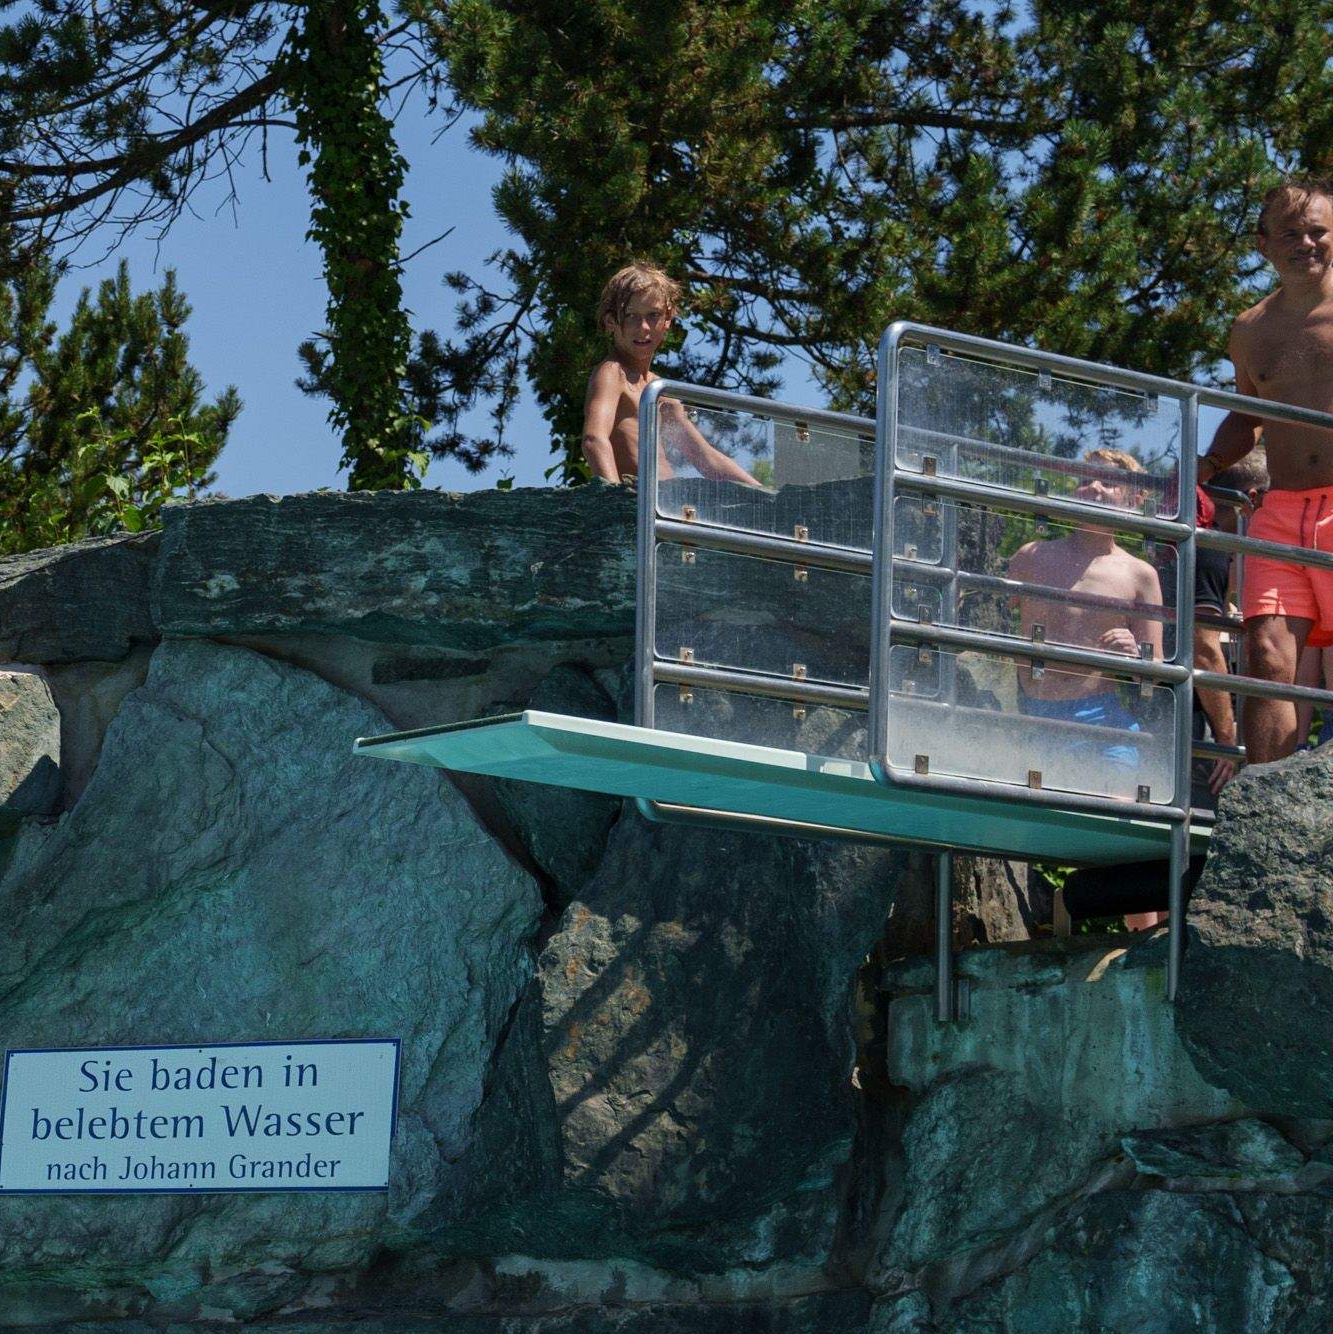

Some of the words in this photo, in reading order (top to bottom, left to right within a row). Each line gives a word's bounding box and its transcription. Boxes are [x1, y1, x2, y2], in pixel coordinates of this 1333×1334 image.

[80, 1060, 134, 1092] Sie
[151, 1057, 264, 1090] baden
[284, 1055, 319, 1087] in
[31, 1107, 204, 1140] belebtem
[221, 1104, 365, 1137] Wasser
[46, 1157, 108, 1180] nach
[118, 1156, 216, 1180] Johann
[229, 1153, 342, 1178] Grander
